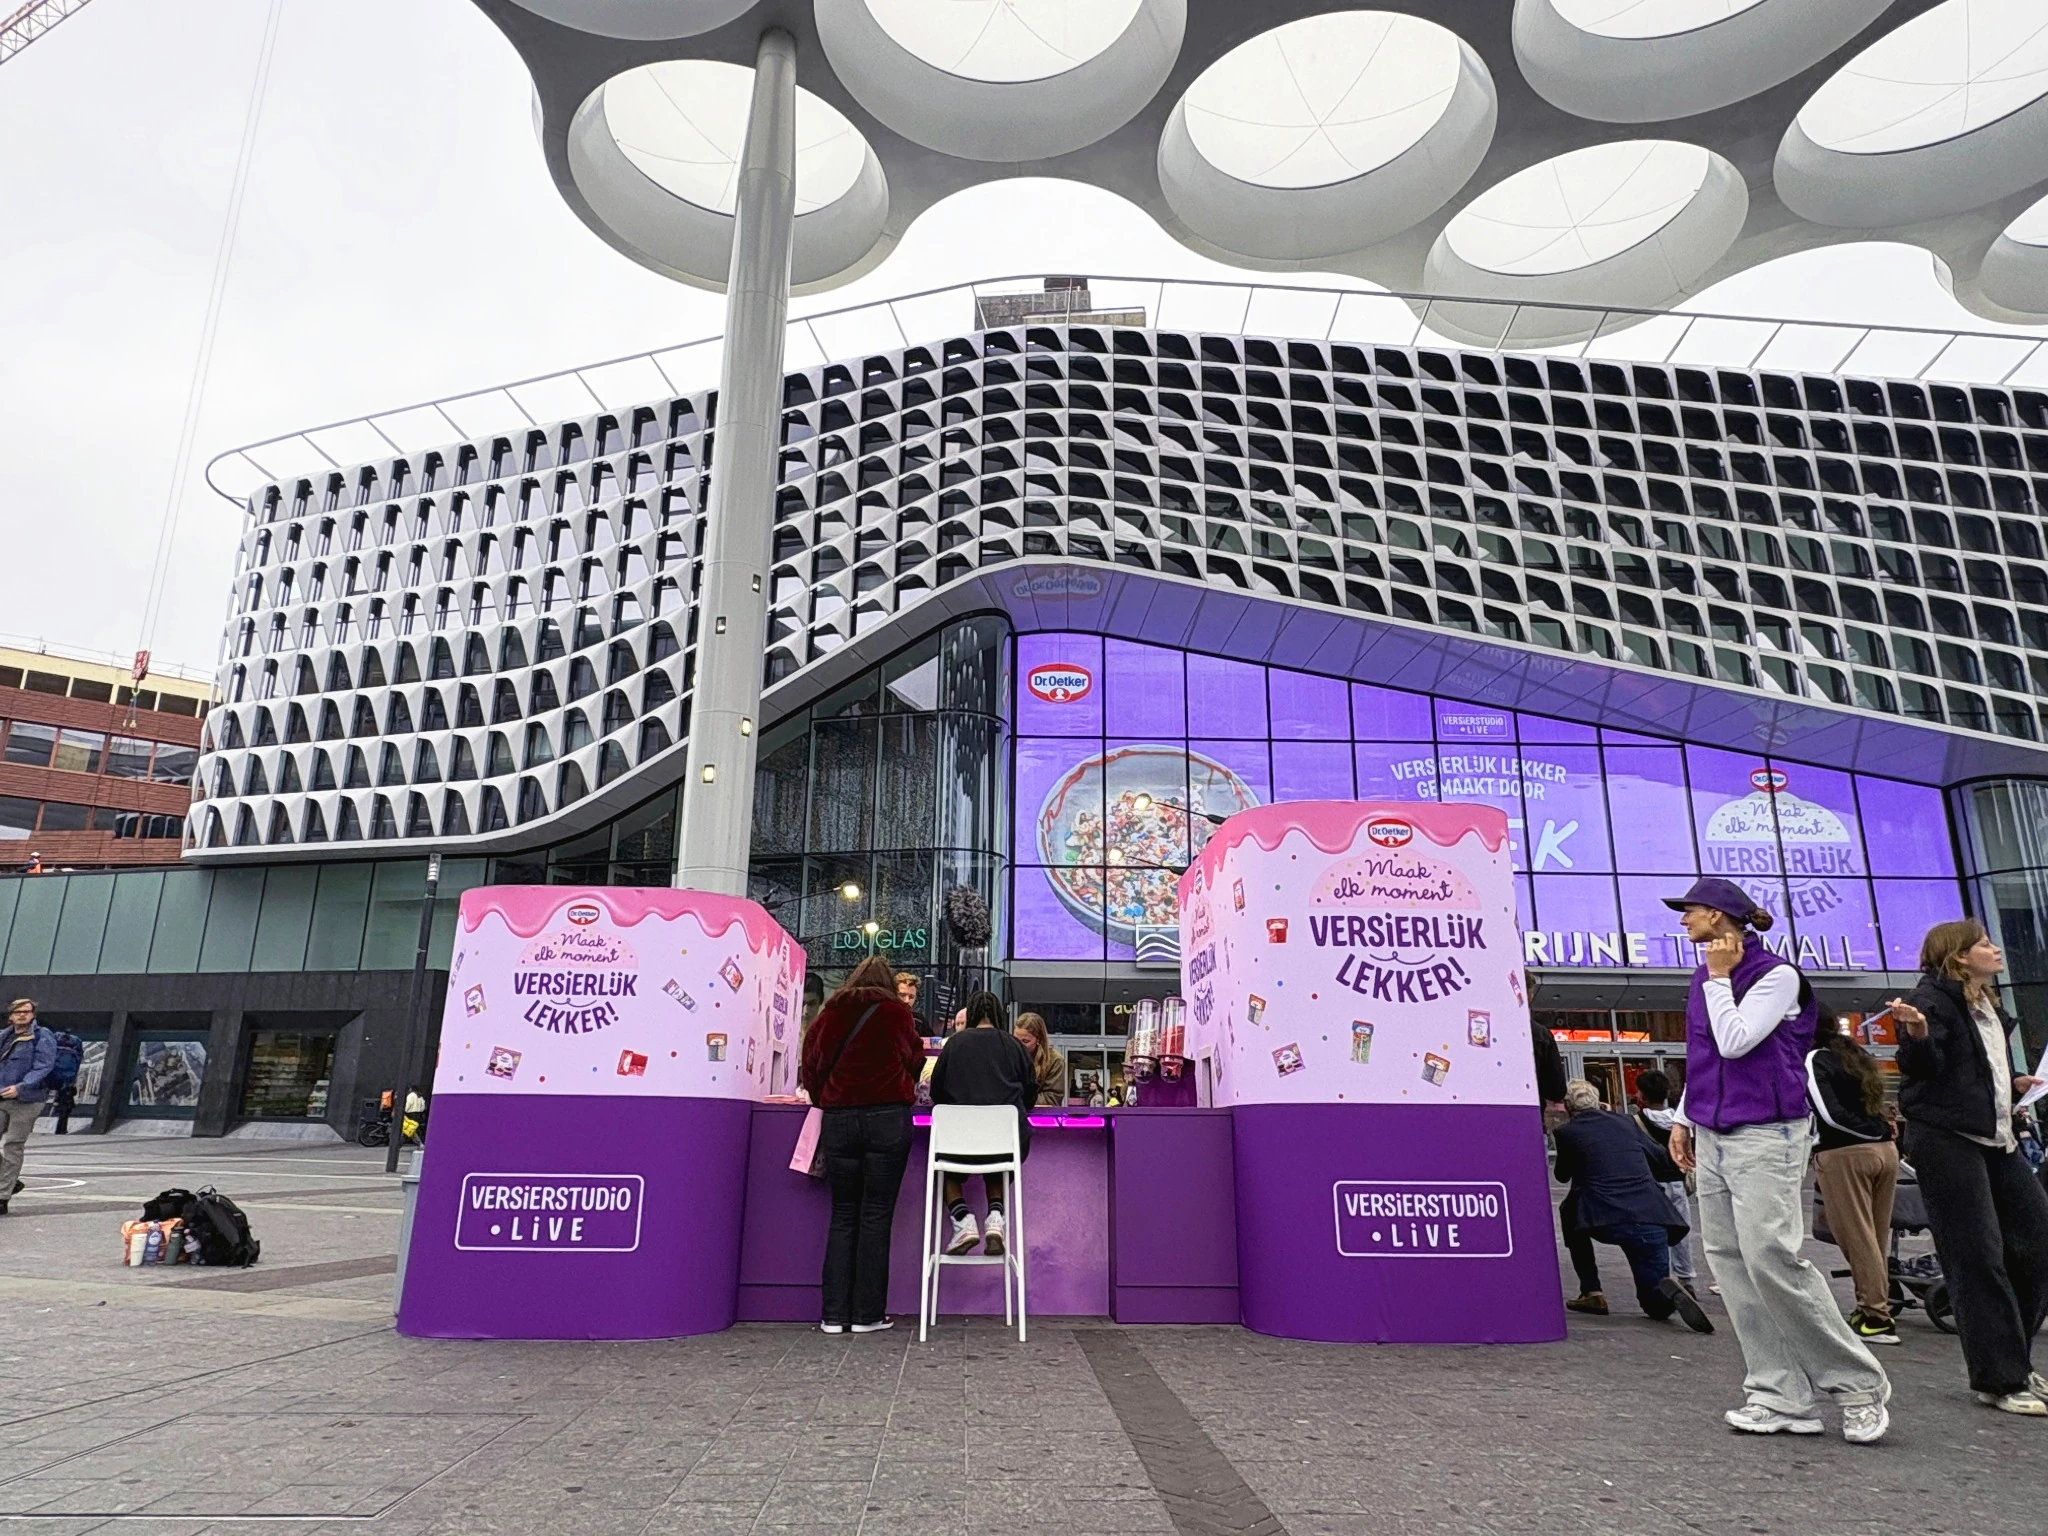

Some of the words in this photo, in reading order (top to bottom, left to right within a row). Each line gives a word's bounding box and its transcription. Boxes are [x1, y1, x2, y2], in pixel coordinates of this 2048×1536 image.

[1365, 859, 1432, 880] Maak
[1333, 877, 1365, 899] elk
[1371, 880, 1453, 902] moment
[560, 933, 607, 947] Maak
[1523, 931, 1649, 964] RIJNE
[534, 946, 557, 962] elk
[560, 948, 620, 963] moment
[1336, 953, 1472, 1004] LEKKER!
[523, 999, 620, 1035] LEKKER!
